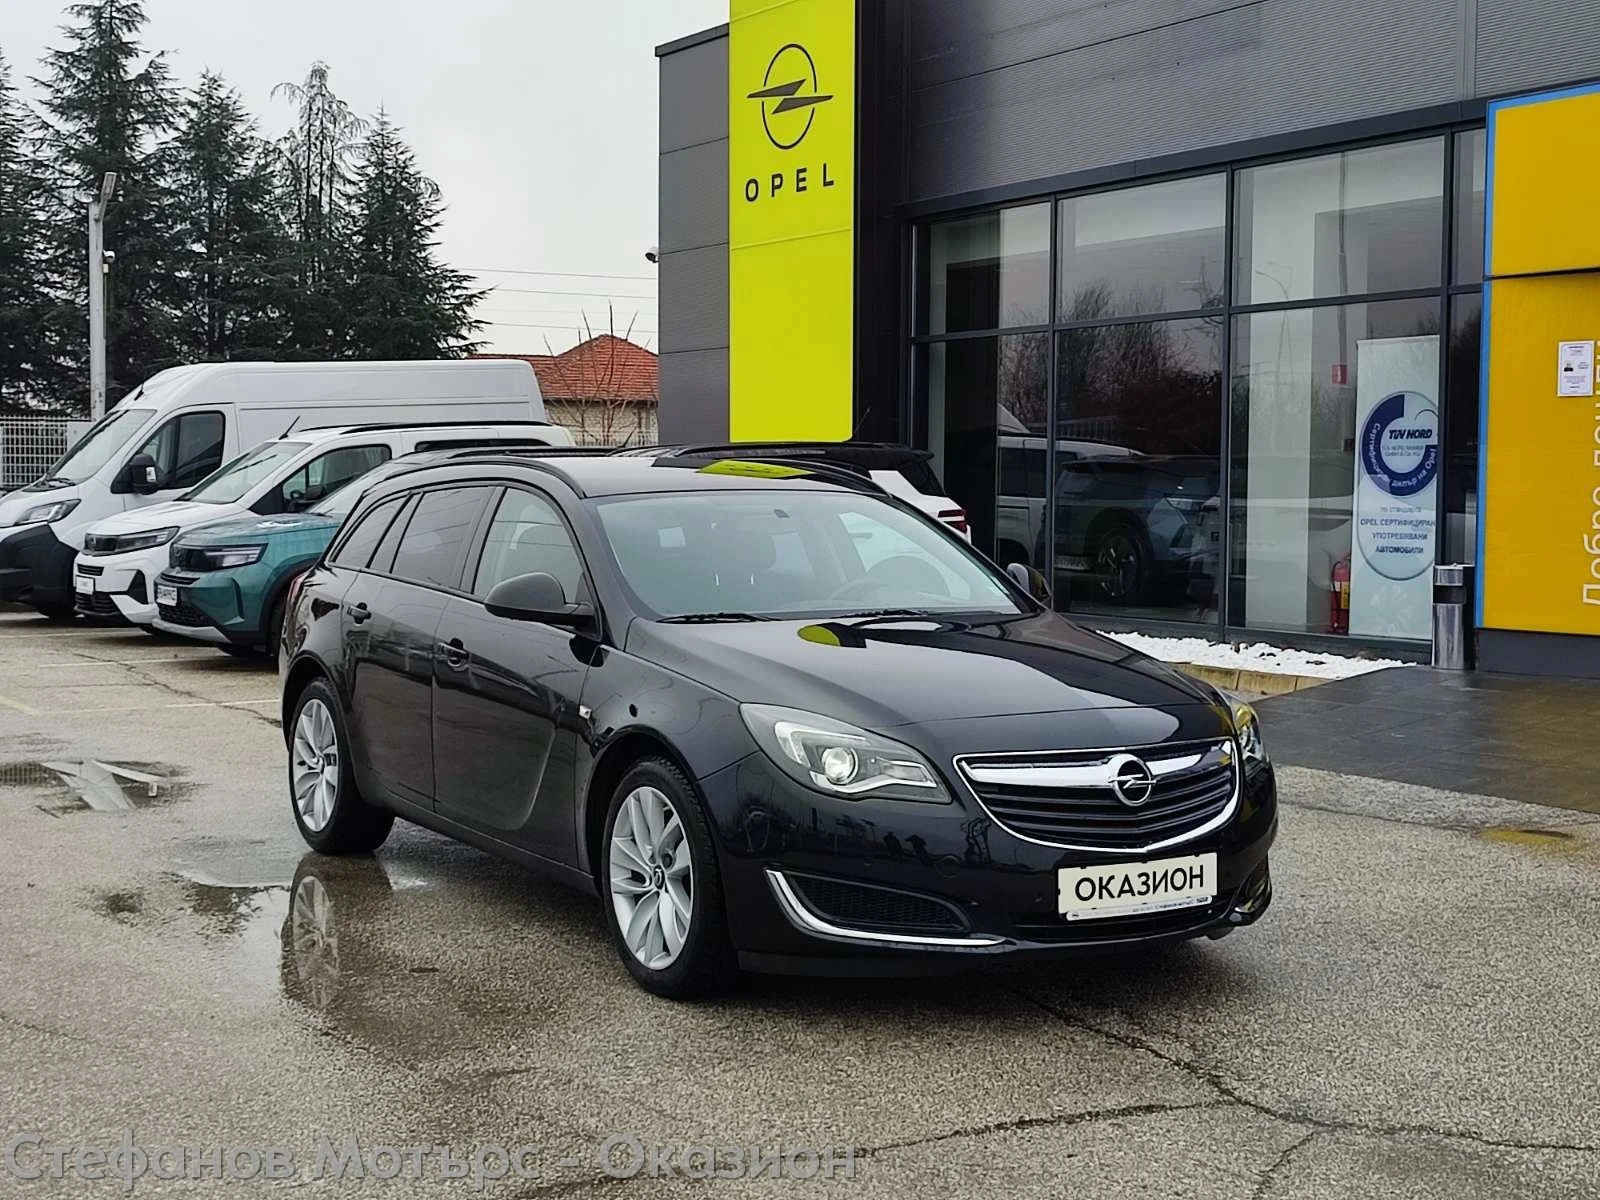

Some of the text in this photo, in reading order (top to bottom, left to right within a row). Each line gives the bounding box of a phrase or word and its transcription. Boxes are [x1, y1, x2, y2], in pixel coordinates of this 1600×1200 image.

[744, 162, 835, 203] OPEL
[1389, 429, 1432, 440] TÜV NORD
[1425, 448, 1437, 469] Opel
[1380, 519, 1437, 528] СЕРТИФИЦИРАН
[1375, 545, 1424, 554] АВТОМОБИЛИ
[1074, 864, 1204, 902] ОКАЗИОН
